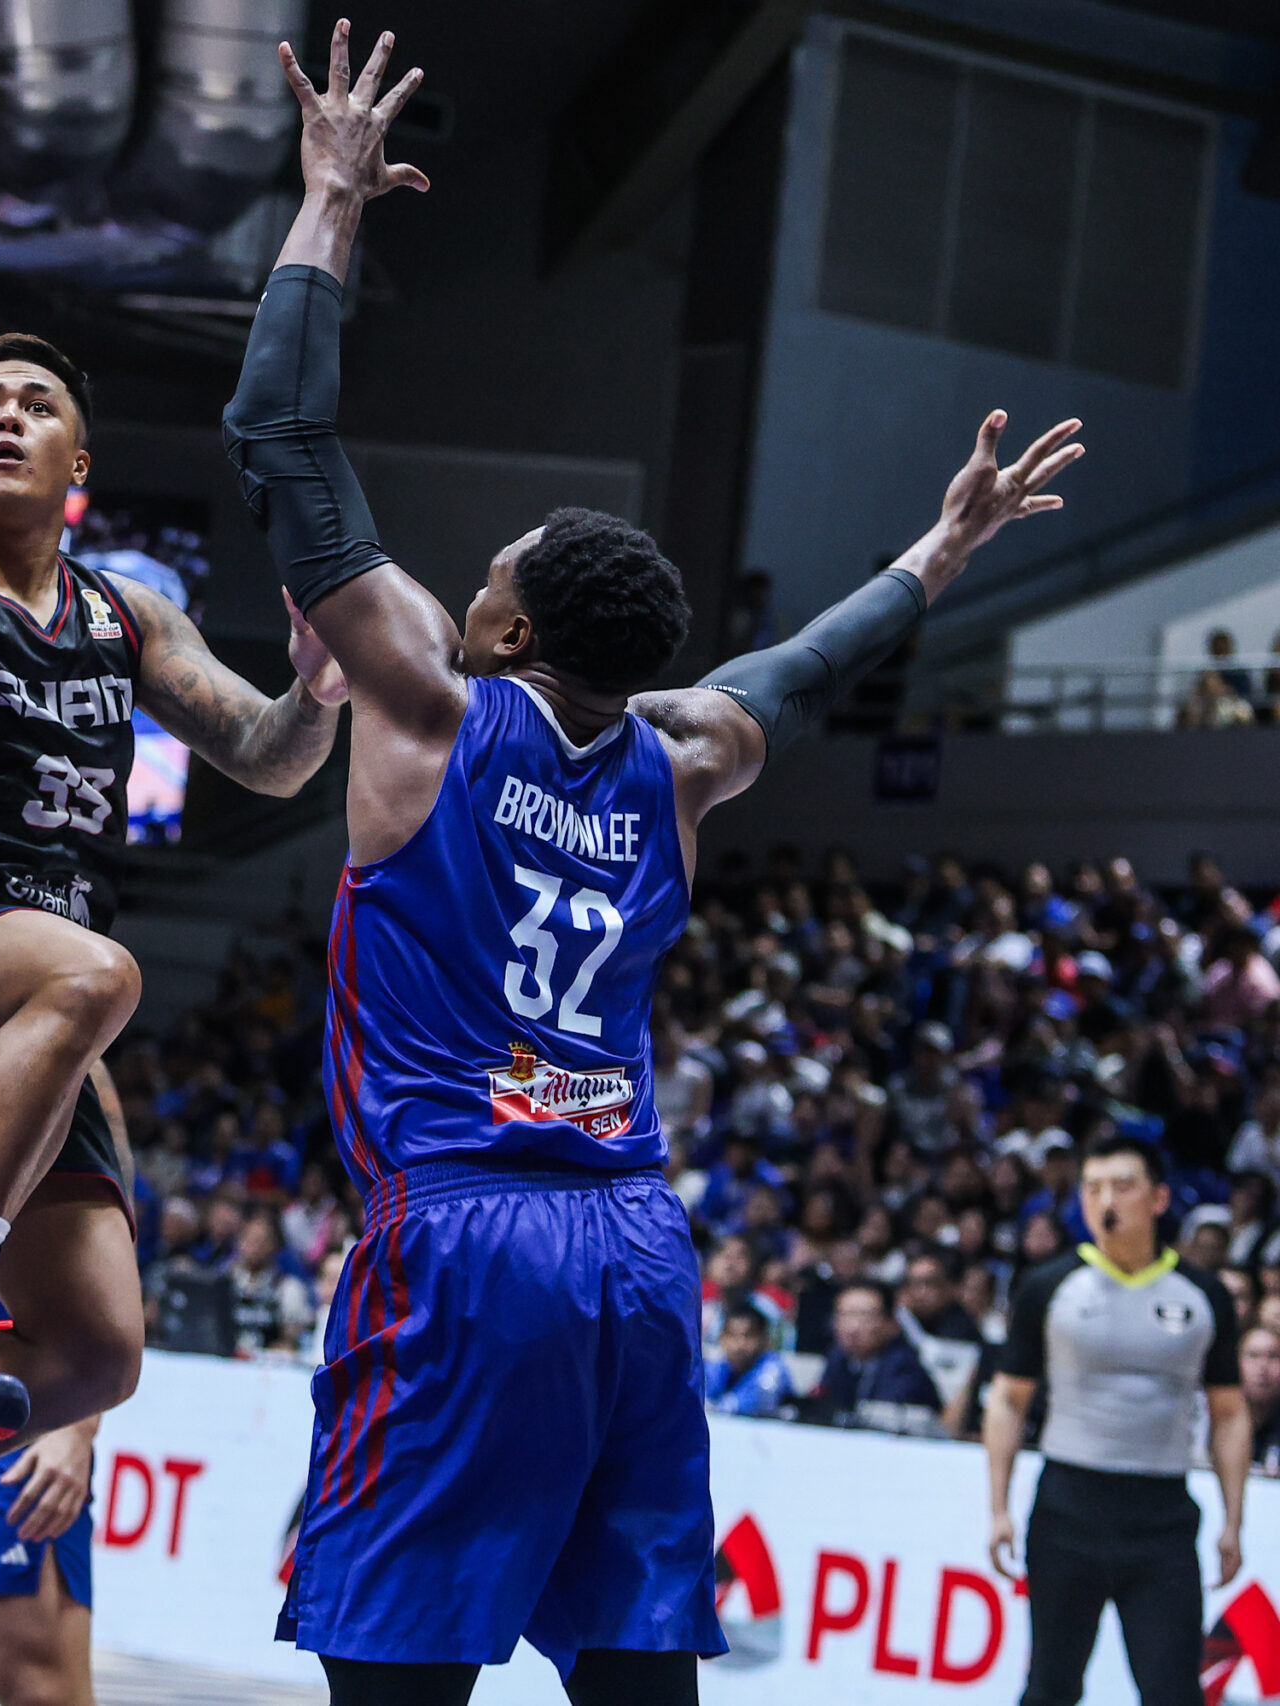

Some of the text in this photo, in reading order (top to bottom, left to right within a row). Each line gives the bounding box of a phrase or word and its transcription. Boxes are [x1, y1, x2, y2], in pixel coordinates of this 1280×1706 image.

[493, 775, 640, 862] BROWNLEE
[6, 876, 69, 916] Guam
[503, 864, 624, 1037] 32
[806, 1548, 1030, 1686] PLD
